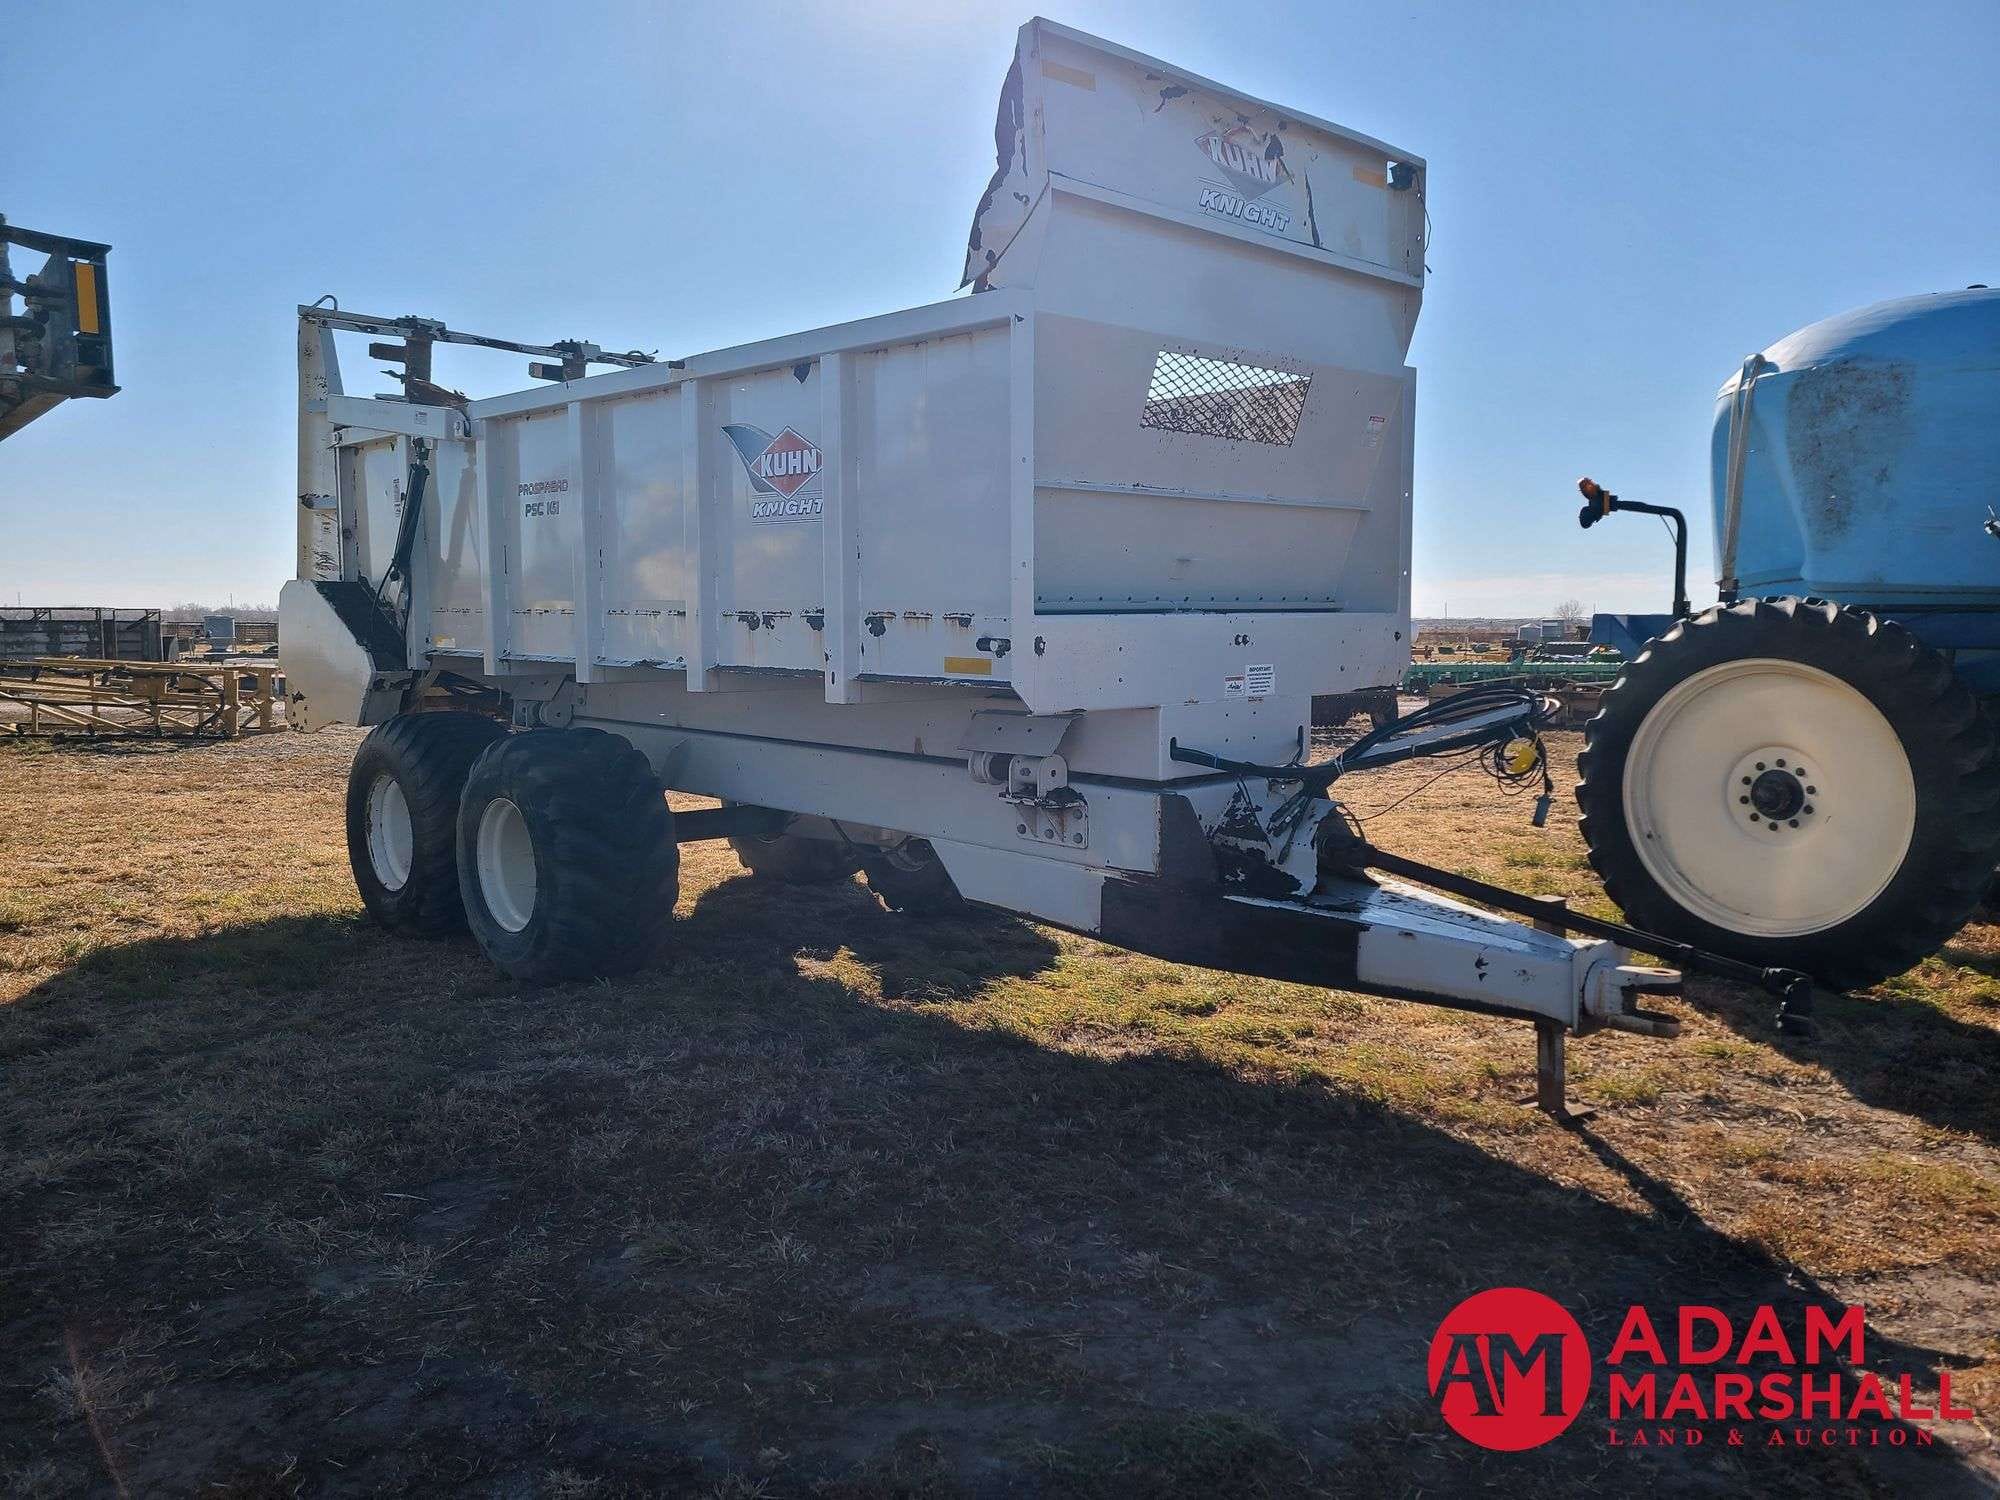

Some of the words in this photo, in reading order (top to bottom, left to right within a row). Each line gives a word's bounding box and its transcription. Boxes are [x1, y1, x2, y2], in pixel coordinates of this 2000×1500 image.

[1199, 188, 1290, 232] KNIGHT
[760, 448, 818, 478] KUHN
[752, 498, 823, 518] KNIGHT
